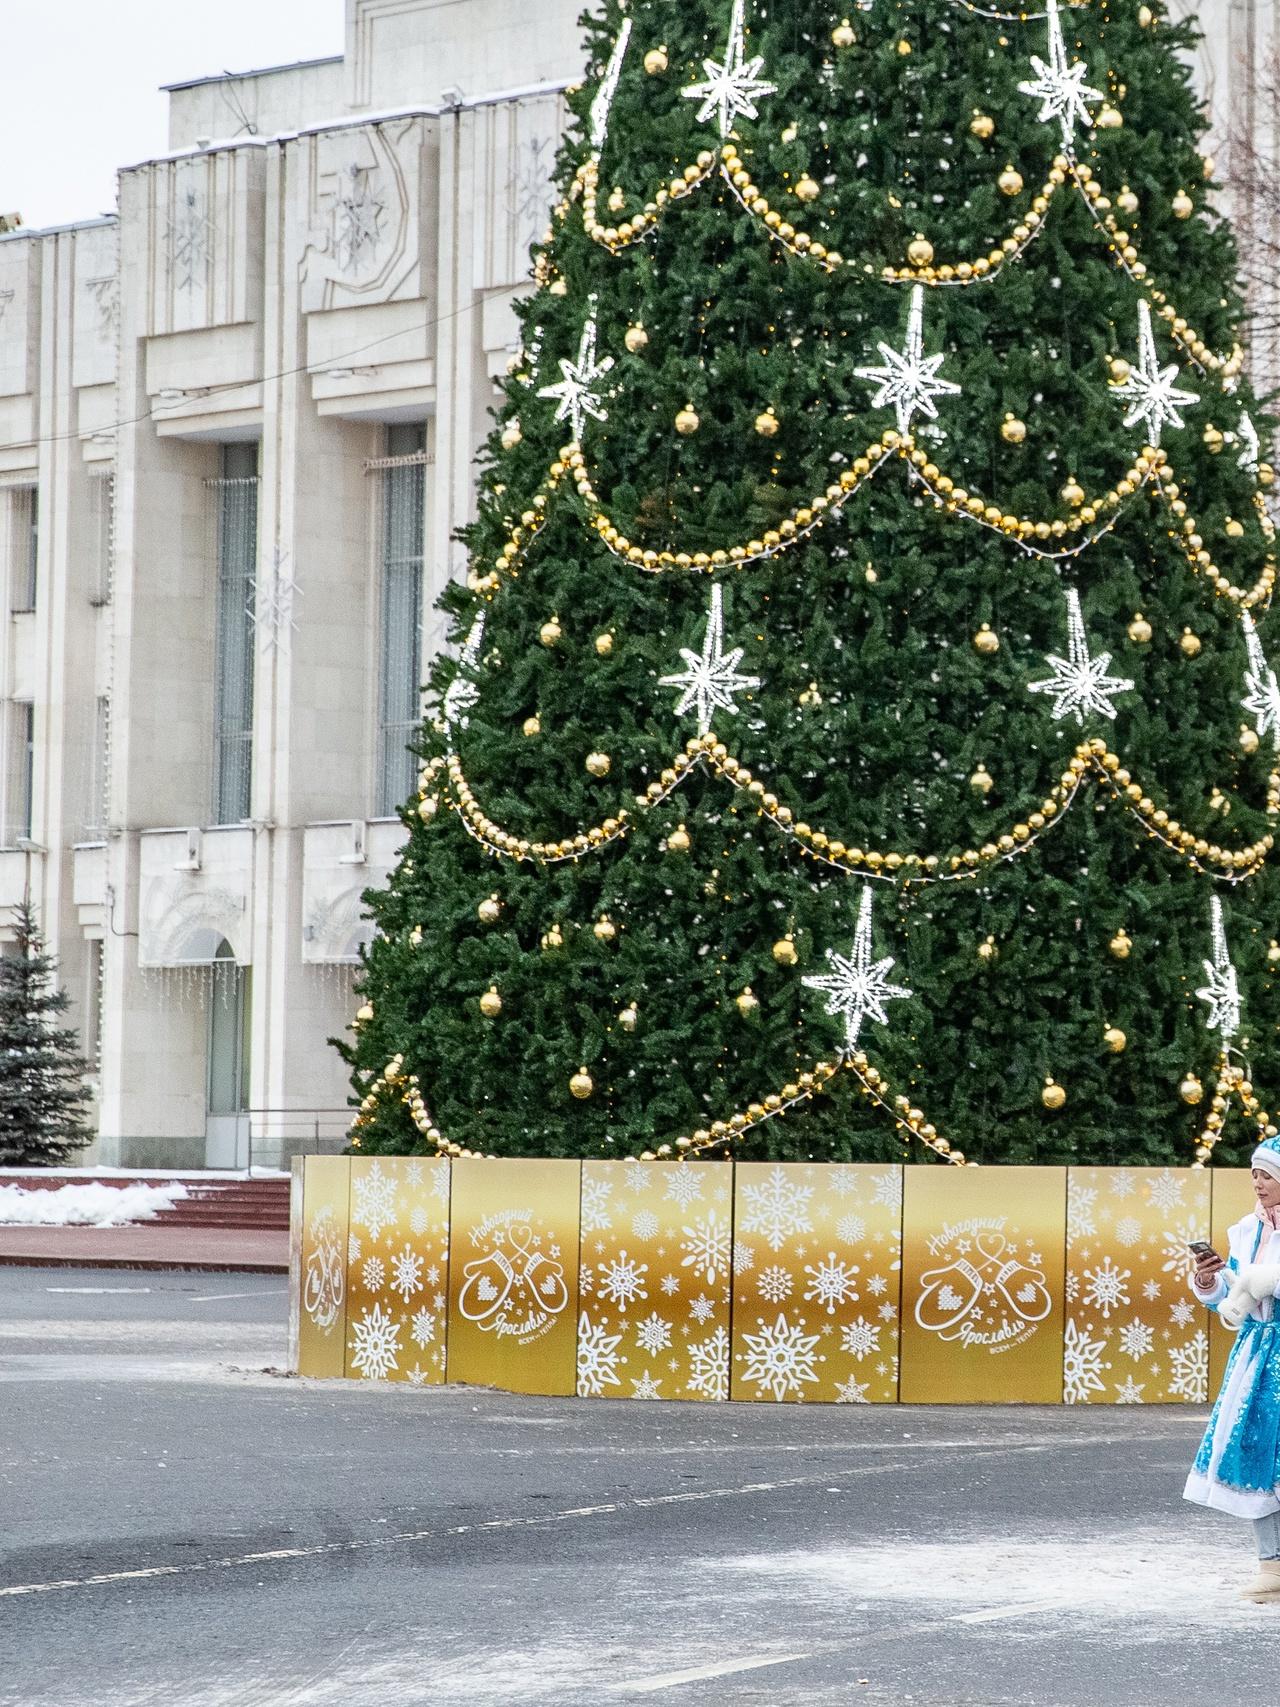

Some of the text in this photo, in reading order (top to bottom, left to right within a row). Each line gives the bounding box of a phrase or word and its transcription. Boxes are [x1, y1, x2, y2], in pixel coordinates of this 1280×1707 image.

[468, 1209, 533, 1247] Новогодний
[926, 1215, 1008, 1256] Новогодний
[477, 1309, 548, 1340] Ярославль
[937, 1318, 1026, 1349] Ярославль
[989, 1342, 1011, 1355] ВСЕМ
[1016, 1323, 1040, 1345] ТЕПЛА!
